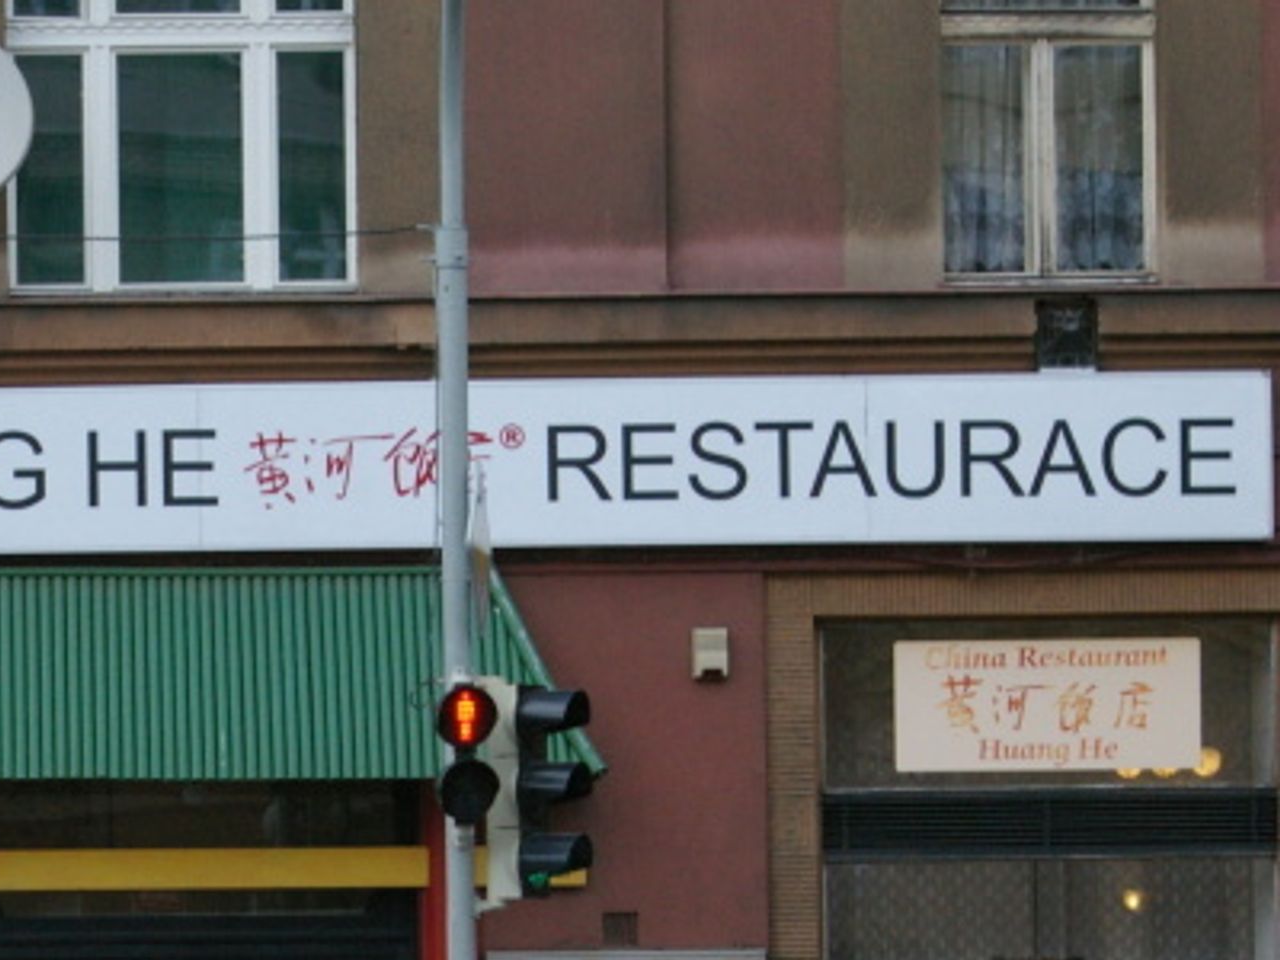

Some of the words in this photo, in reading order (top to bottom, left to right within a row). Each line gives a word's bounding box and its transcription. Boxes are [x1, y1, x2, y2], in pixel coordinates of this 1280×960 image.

[88, 429, 220, 508] HE
[546, 418, 1238, 502] RESTAURACE
[925, 642, 1007, 670] China
[1017, 644, 1169, 669] Restaurant
[978, 738, 1070, 767] Huang
[1078, 737, 1119, 760] He
